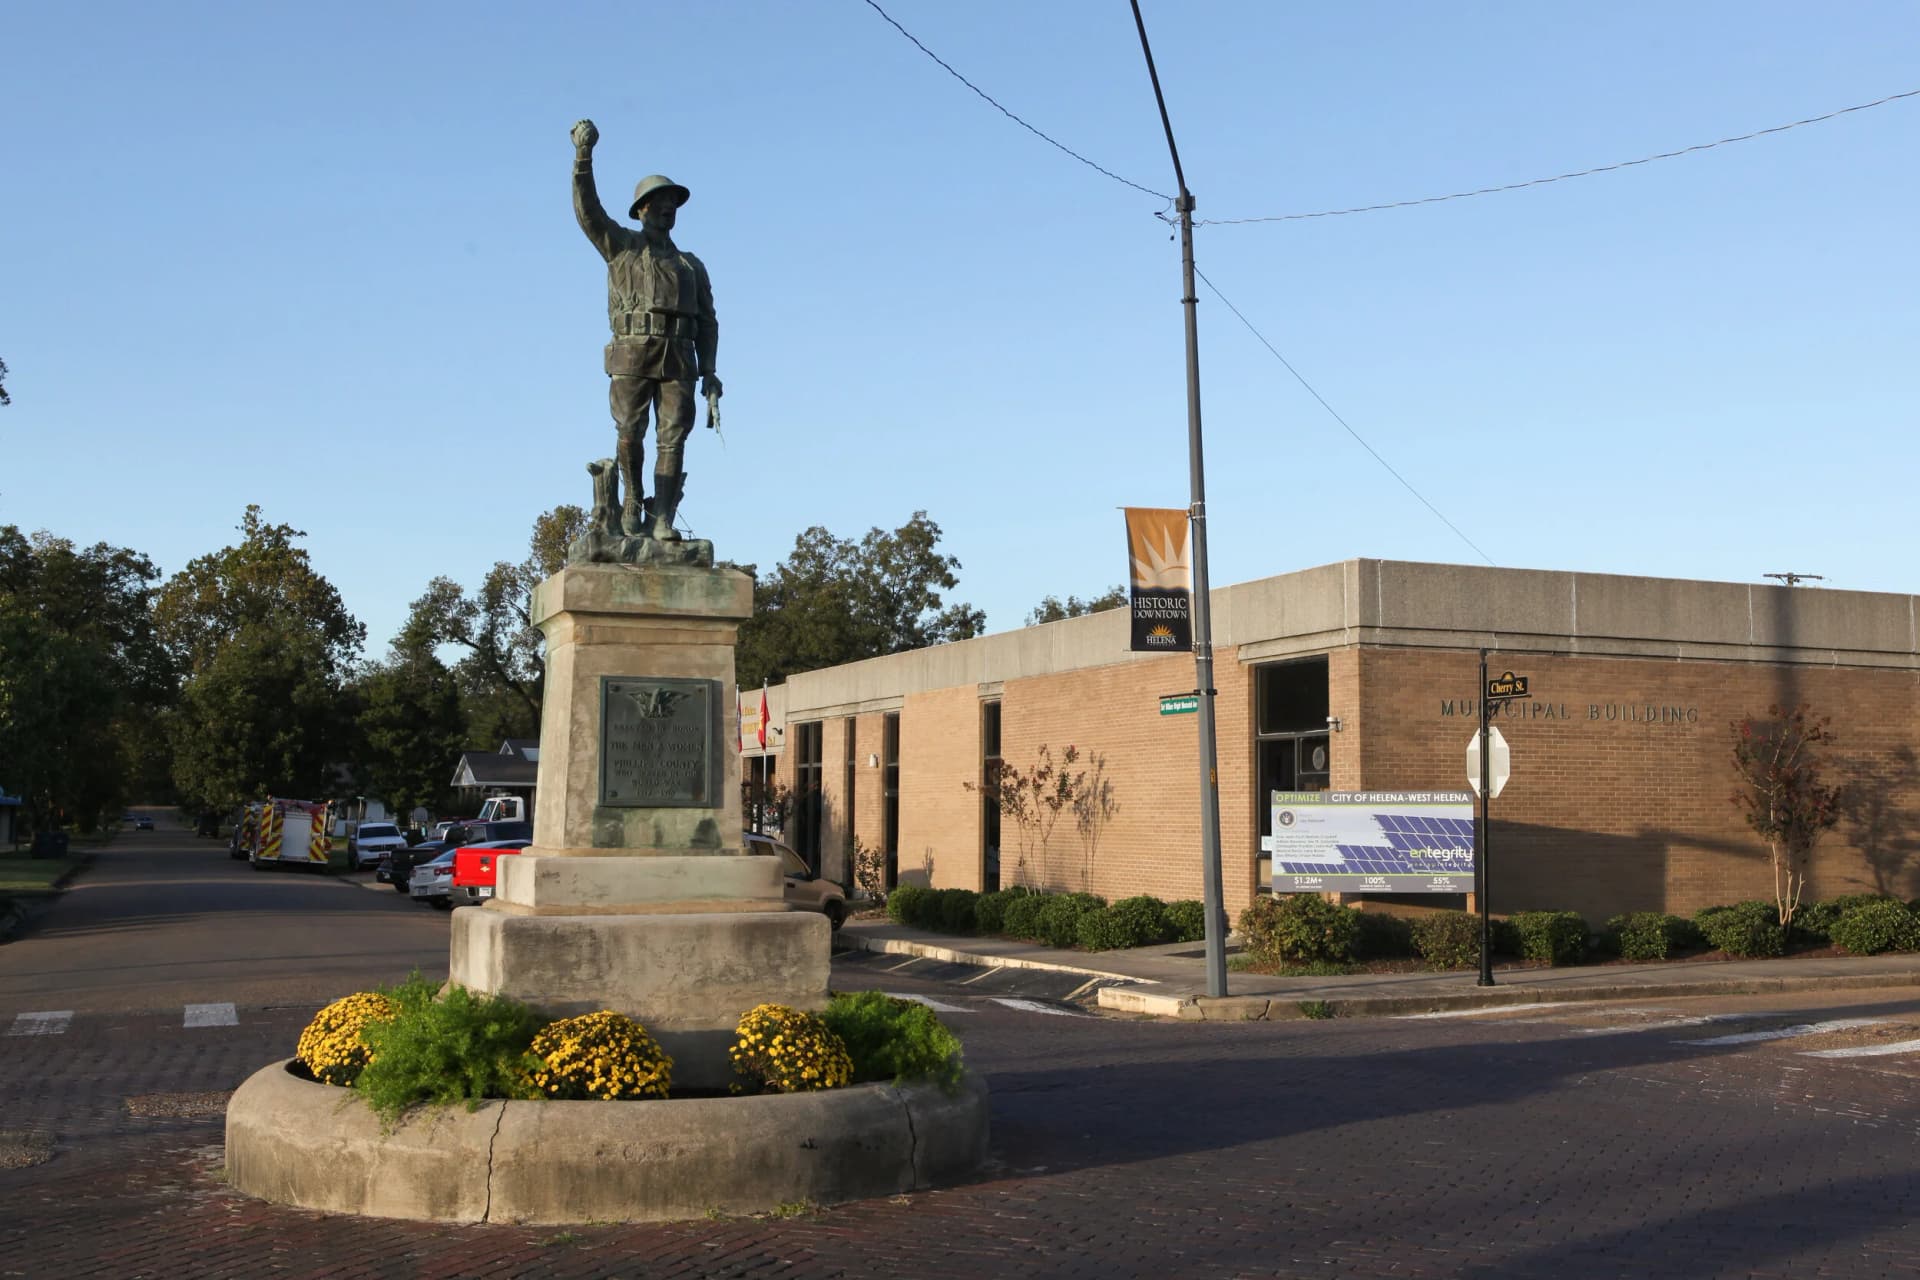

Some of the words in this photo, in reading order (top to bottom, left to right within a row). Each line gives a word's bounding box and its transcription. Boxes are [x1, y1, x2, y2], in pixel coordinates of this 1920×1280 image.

[1134, 597, 1187, 609] HISTORIC
[1133, 609, 1188, 619] DOWNTOWN
[1146, 635, 1177, 644] HELENA
[1491, 682, 1514, 695] Cherry
[1440, 699, 1571, 720] MUCIPAL
[1587, 703, 1699, 723] BUILDING
[1275, 793, 1321, 802] OPTIMIZE
[1331, 793, 1354, 802] CITY
[1354, 793, 1368, 802] OF
[1369, 793, 1431, 802] HELENA-WEST
[1433, 793, 1469, 802] HELENA
[1409, 845, 1473, 862] entegrity
[1294, 876, 1322, 885] $1.2M+
[1364, 876, 1386, 885] 100%
[1432, 876, 1451, 885] 55%
